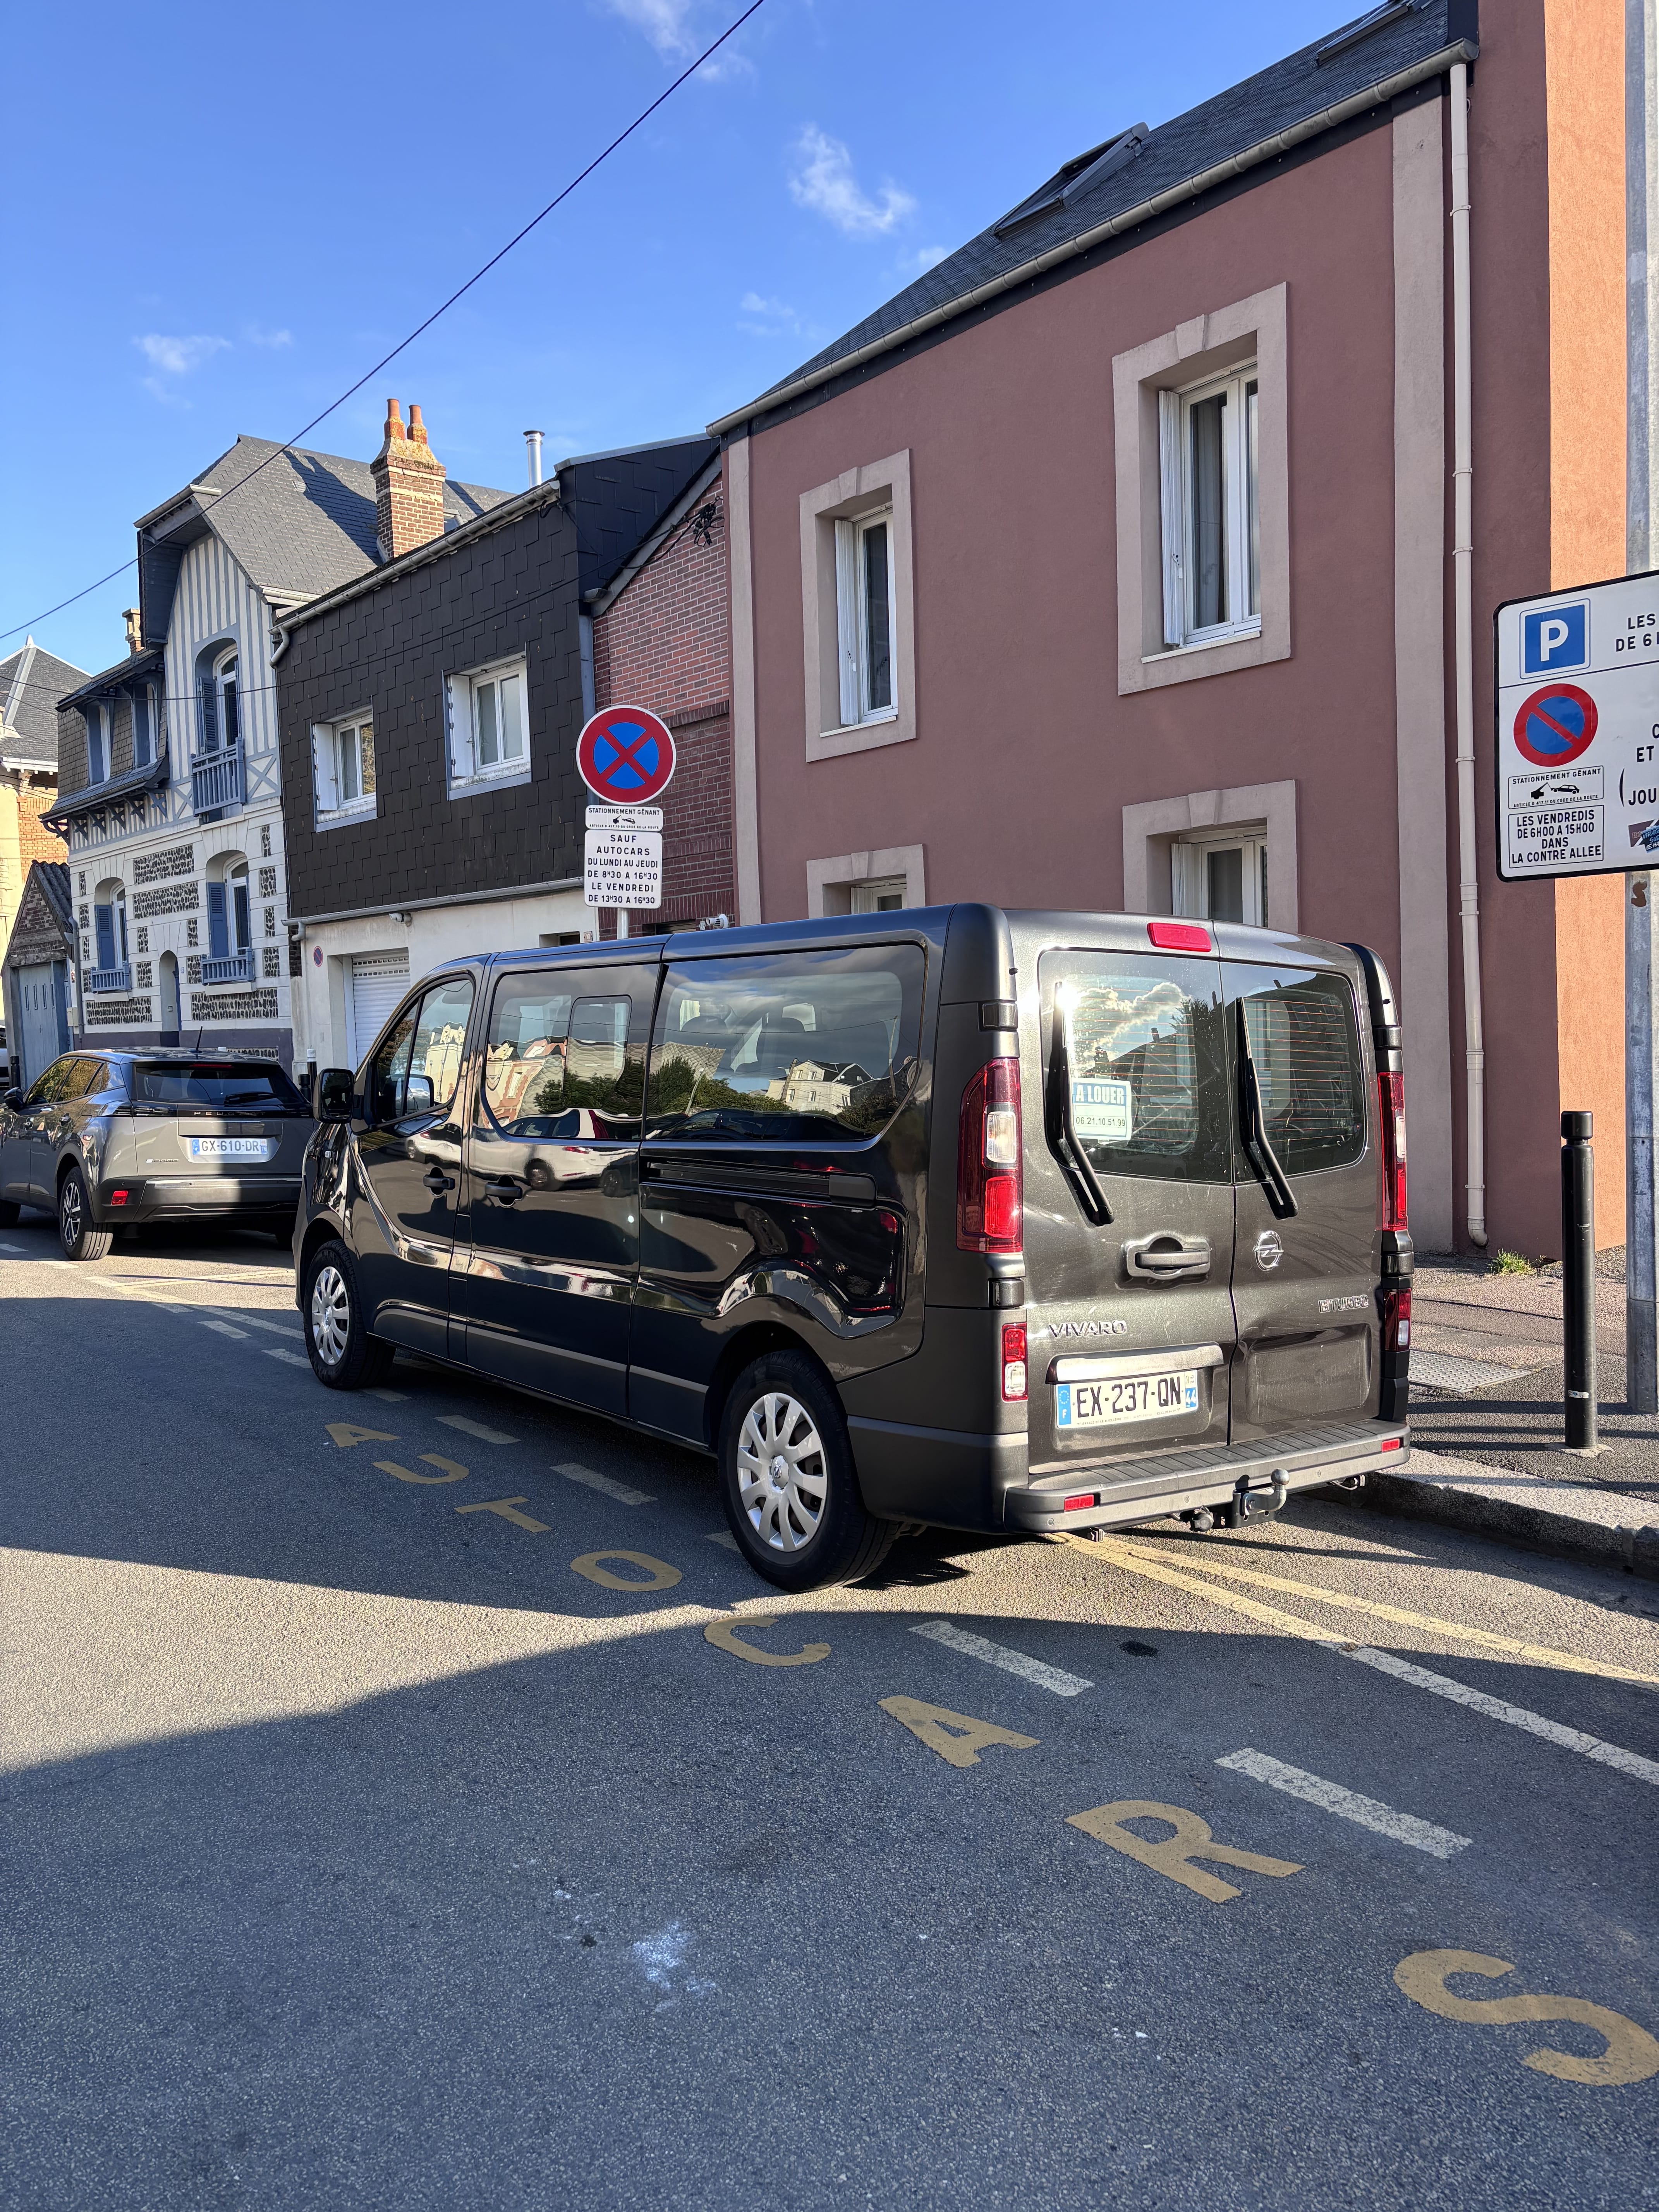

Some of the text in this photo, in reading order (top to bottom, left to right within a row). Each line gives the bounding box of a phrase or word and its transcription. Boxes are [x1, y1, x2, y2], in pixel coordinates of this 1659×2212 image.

[1628, 613, 1656, 630] LES
[1540, 619, 1569, 662] P
[1616, 636, 1636, 652] DE
[1637, 745, 1654, 762] ET
[1513, 768, 1601, 784] STATIONNEMENT GÊNANT
[1517, 809, 1594, 827] LES VENDREDIS
[1517, 822, 1594, 839] DE 6H00 A 15H00
[610, 835, 637, 843] SAUF
[1542, 837, 1568, 849] DANS
[596, 846, 650, 855] AUTOCARS
[1512, 845, 1601, 864] LA CONTRE ALLEE
[600, 858, 621, 866] LUNDI
[606, 883, 653, 892] VENDREDI
[1075, 1085, 1124, 1104] A LOUER
[202, 1140, 259, 1151] GX-610-DR
[1049, 1319, 1127, 1338] VIVARO
[1077, 1376, 1181, 1418] EX-237-QN
[1062, 1409, 1067, 1419] F
